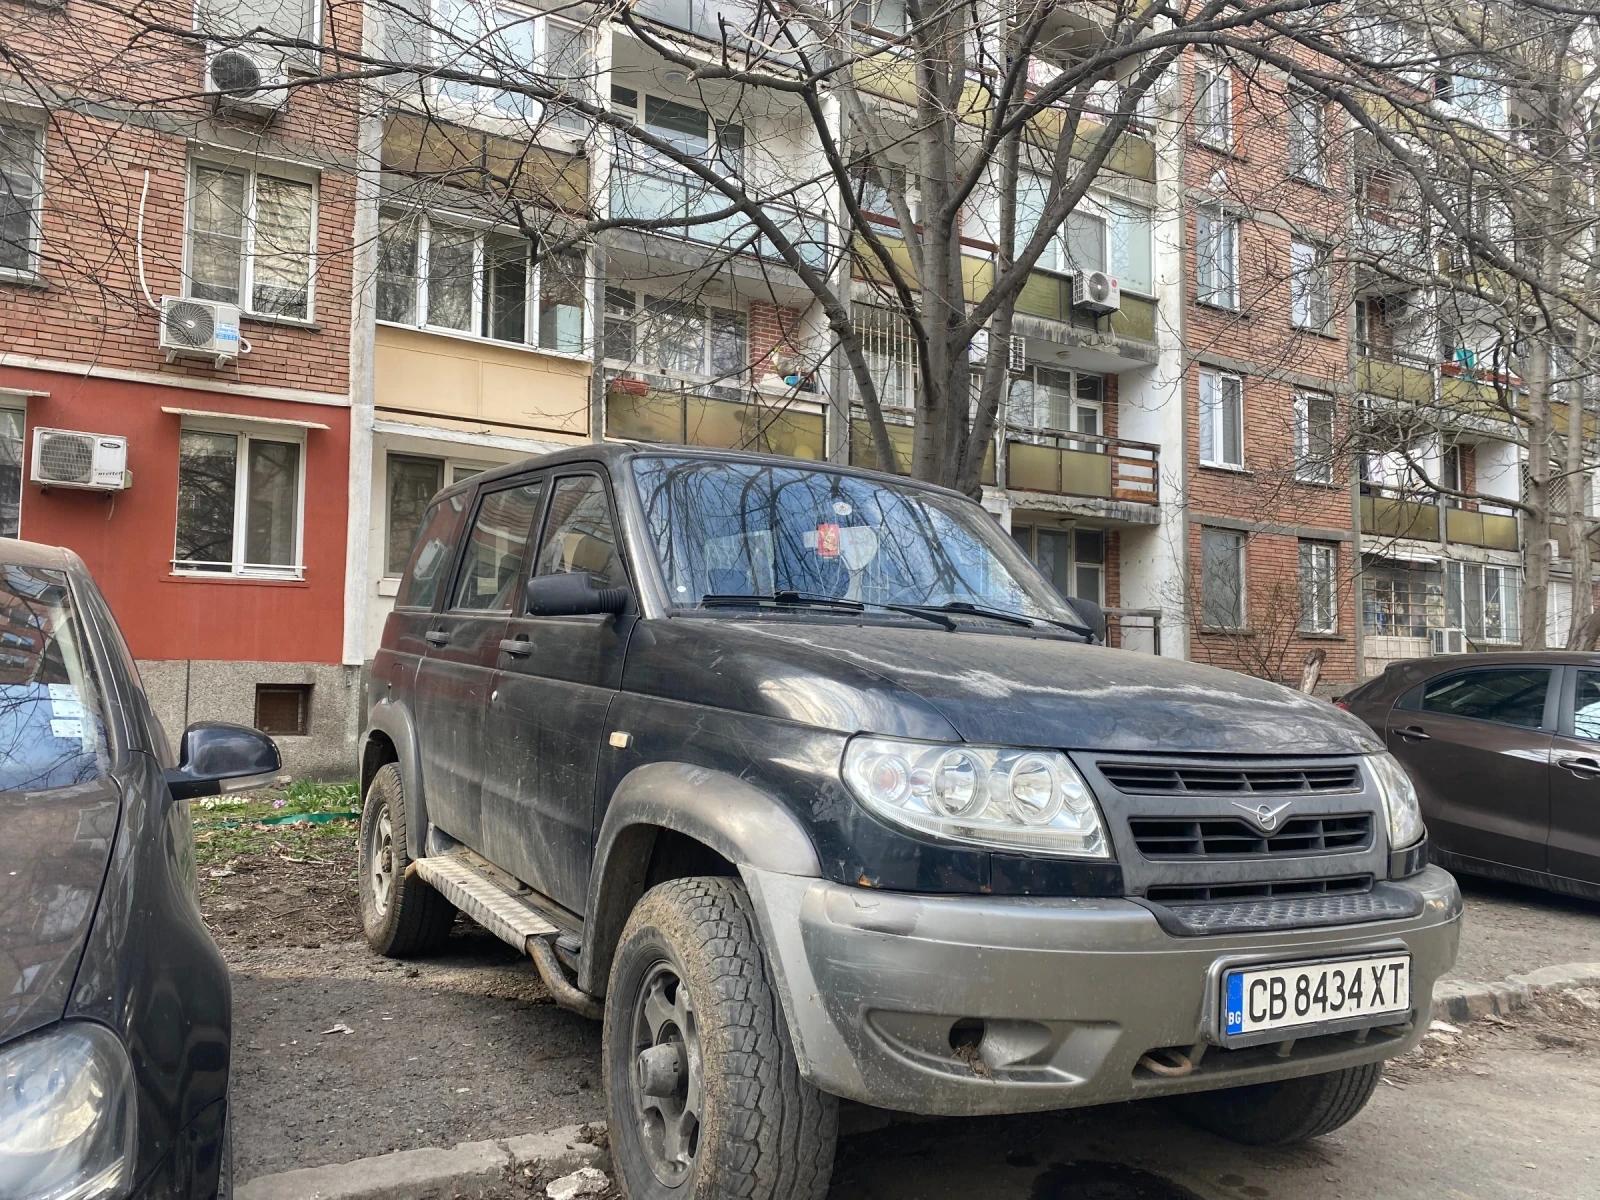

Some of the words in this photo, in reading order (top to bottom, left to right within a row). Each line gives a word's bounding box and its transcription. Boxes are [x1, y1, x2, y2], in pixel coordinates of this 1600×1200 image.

[1249, 976, 1287, 1023] CB
[1294, 967, 1363, 1017] 8434
[1370, 963, 1405, 1007] XT
[1228, 1011, 1242, 1025] BG
